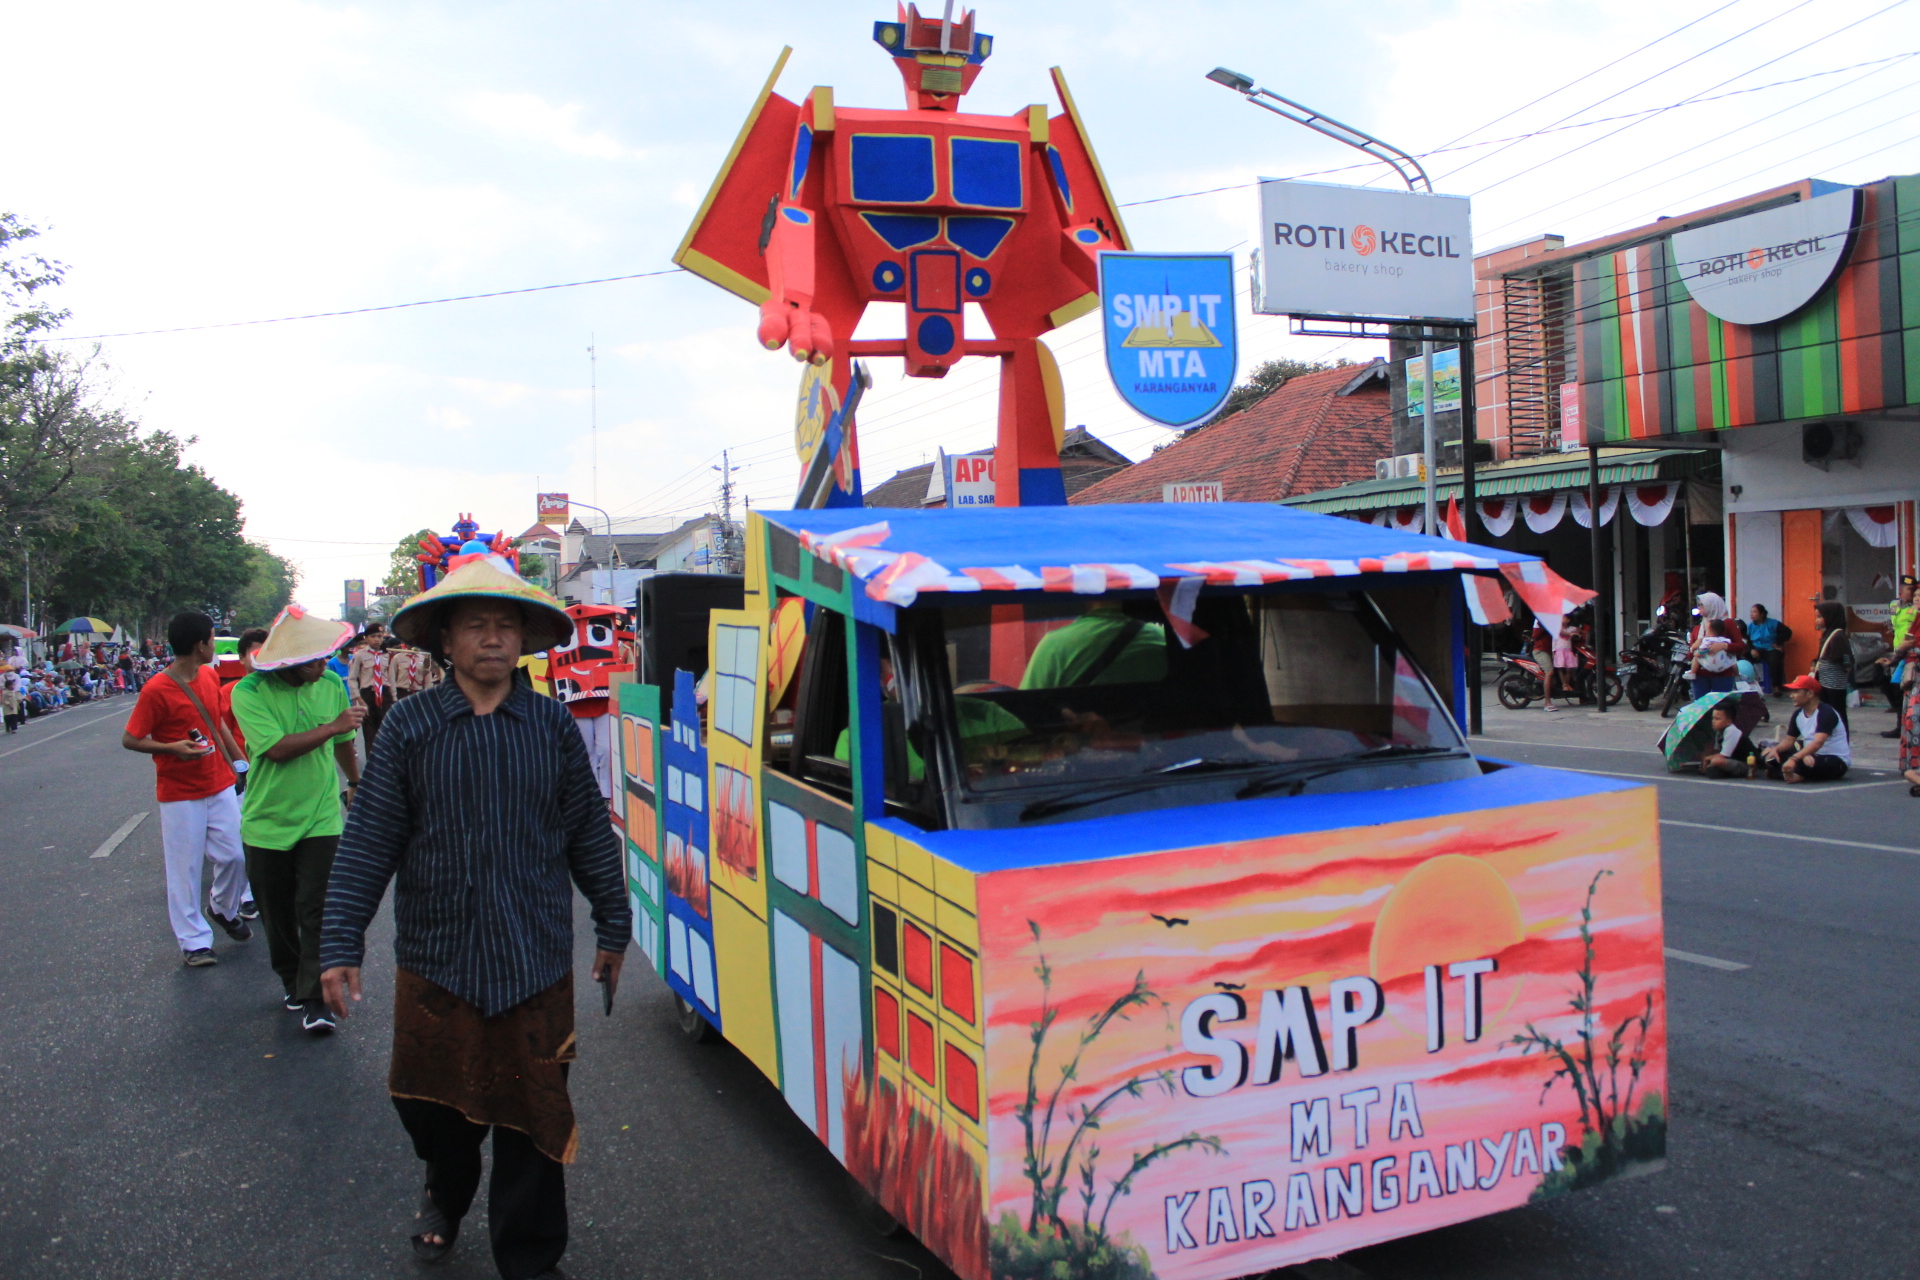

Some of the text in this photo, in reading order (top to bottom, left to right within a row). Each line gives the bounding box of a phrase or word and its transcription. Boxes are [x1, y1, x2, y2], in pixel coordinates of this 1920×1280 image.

[1274, 222, 1460, 259] ROTI KECIL
[1325, 258, 1404, 278] bakery shop
[1698, 236, 1826, 278] ROTI KECIL
[1728, 267, 1782, 286] bakery shop
[1113, 293, 1222, 328] SMP IT
[1138, 349, 1207, 379] MTA
[1134, 381, 1218, 393] KARANGANYAR
[958, 495, 977, 505] LAB.
[1173, 484, 1218, 503] APOTEK
[1180, 958, 1497, 1098] SMP IT
[1290, 1082, 1424, 1163] MTA
[1165, 1121, 1567, 1253] KARANGANYAR
